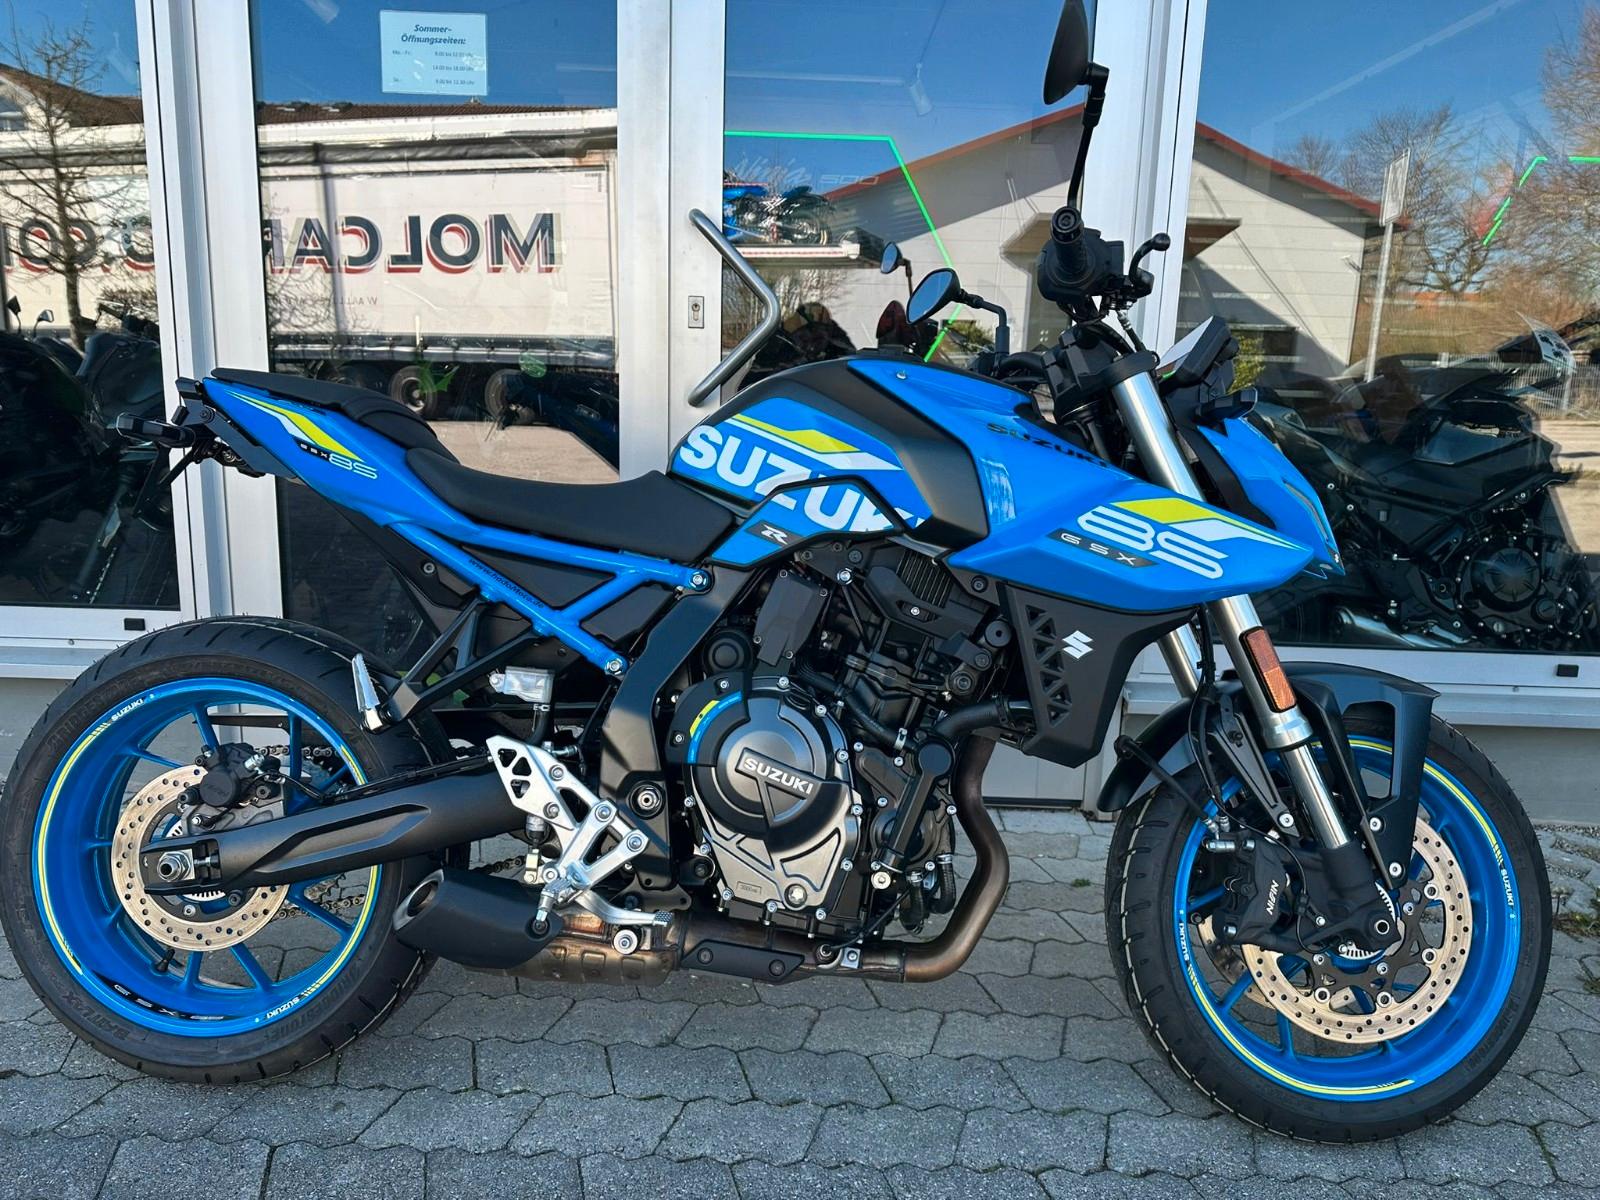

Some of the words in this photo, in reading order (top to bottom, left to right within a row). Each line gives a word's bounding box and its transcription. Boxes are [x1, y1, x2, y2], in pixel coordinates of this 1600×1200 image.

[401, 33, 467, 45] Öffnungszeiten:
[413, 24, 452, 33] Sommer-
[1060, 532, 1137, 566] GSX
[1077, 505, 1229, 580] 8S
[111, 698, 145, 721] SUZUKI
[743, 757, 814, 795] SUZUKI
[1500, 868, 1515, 906] SUZUKI
[1178, 922, 1190, 961] SUZUKI
[266, 996, 300, 1019] SUZUKI
